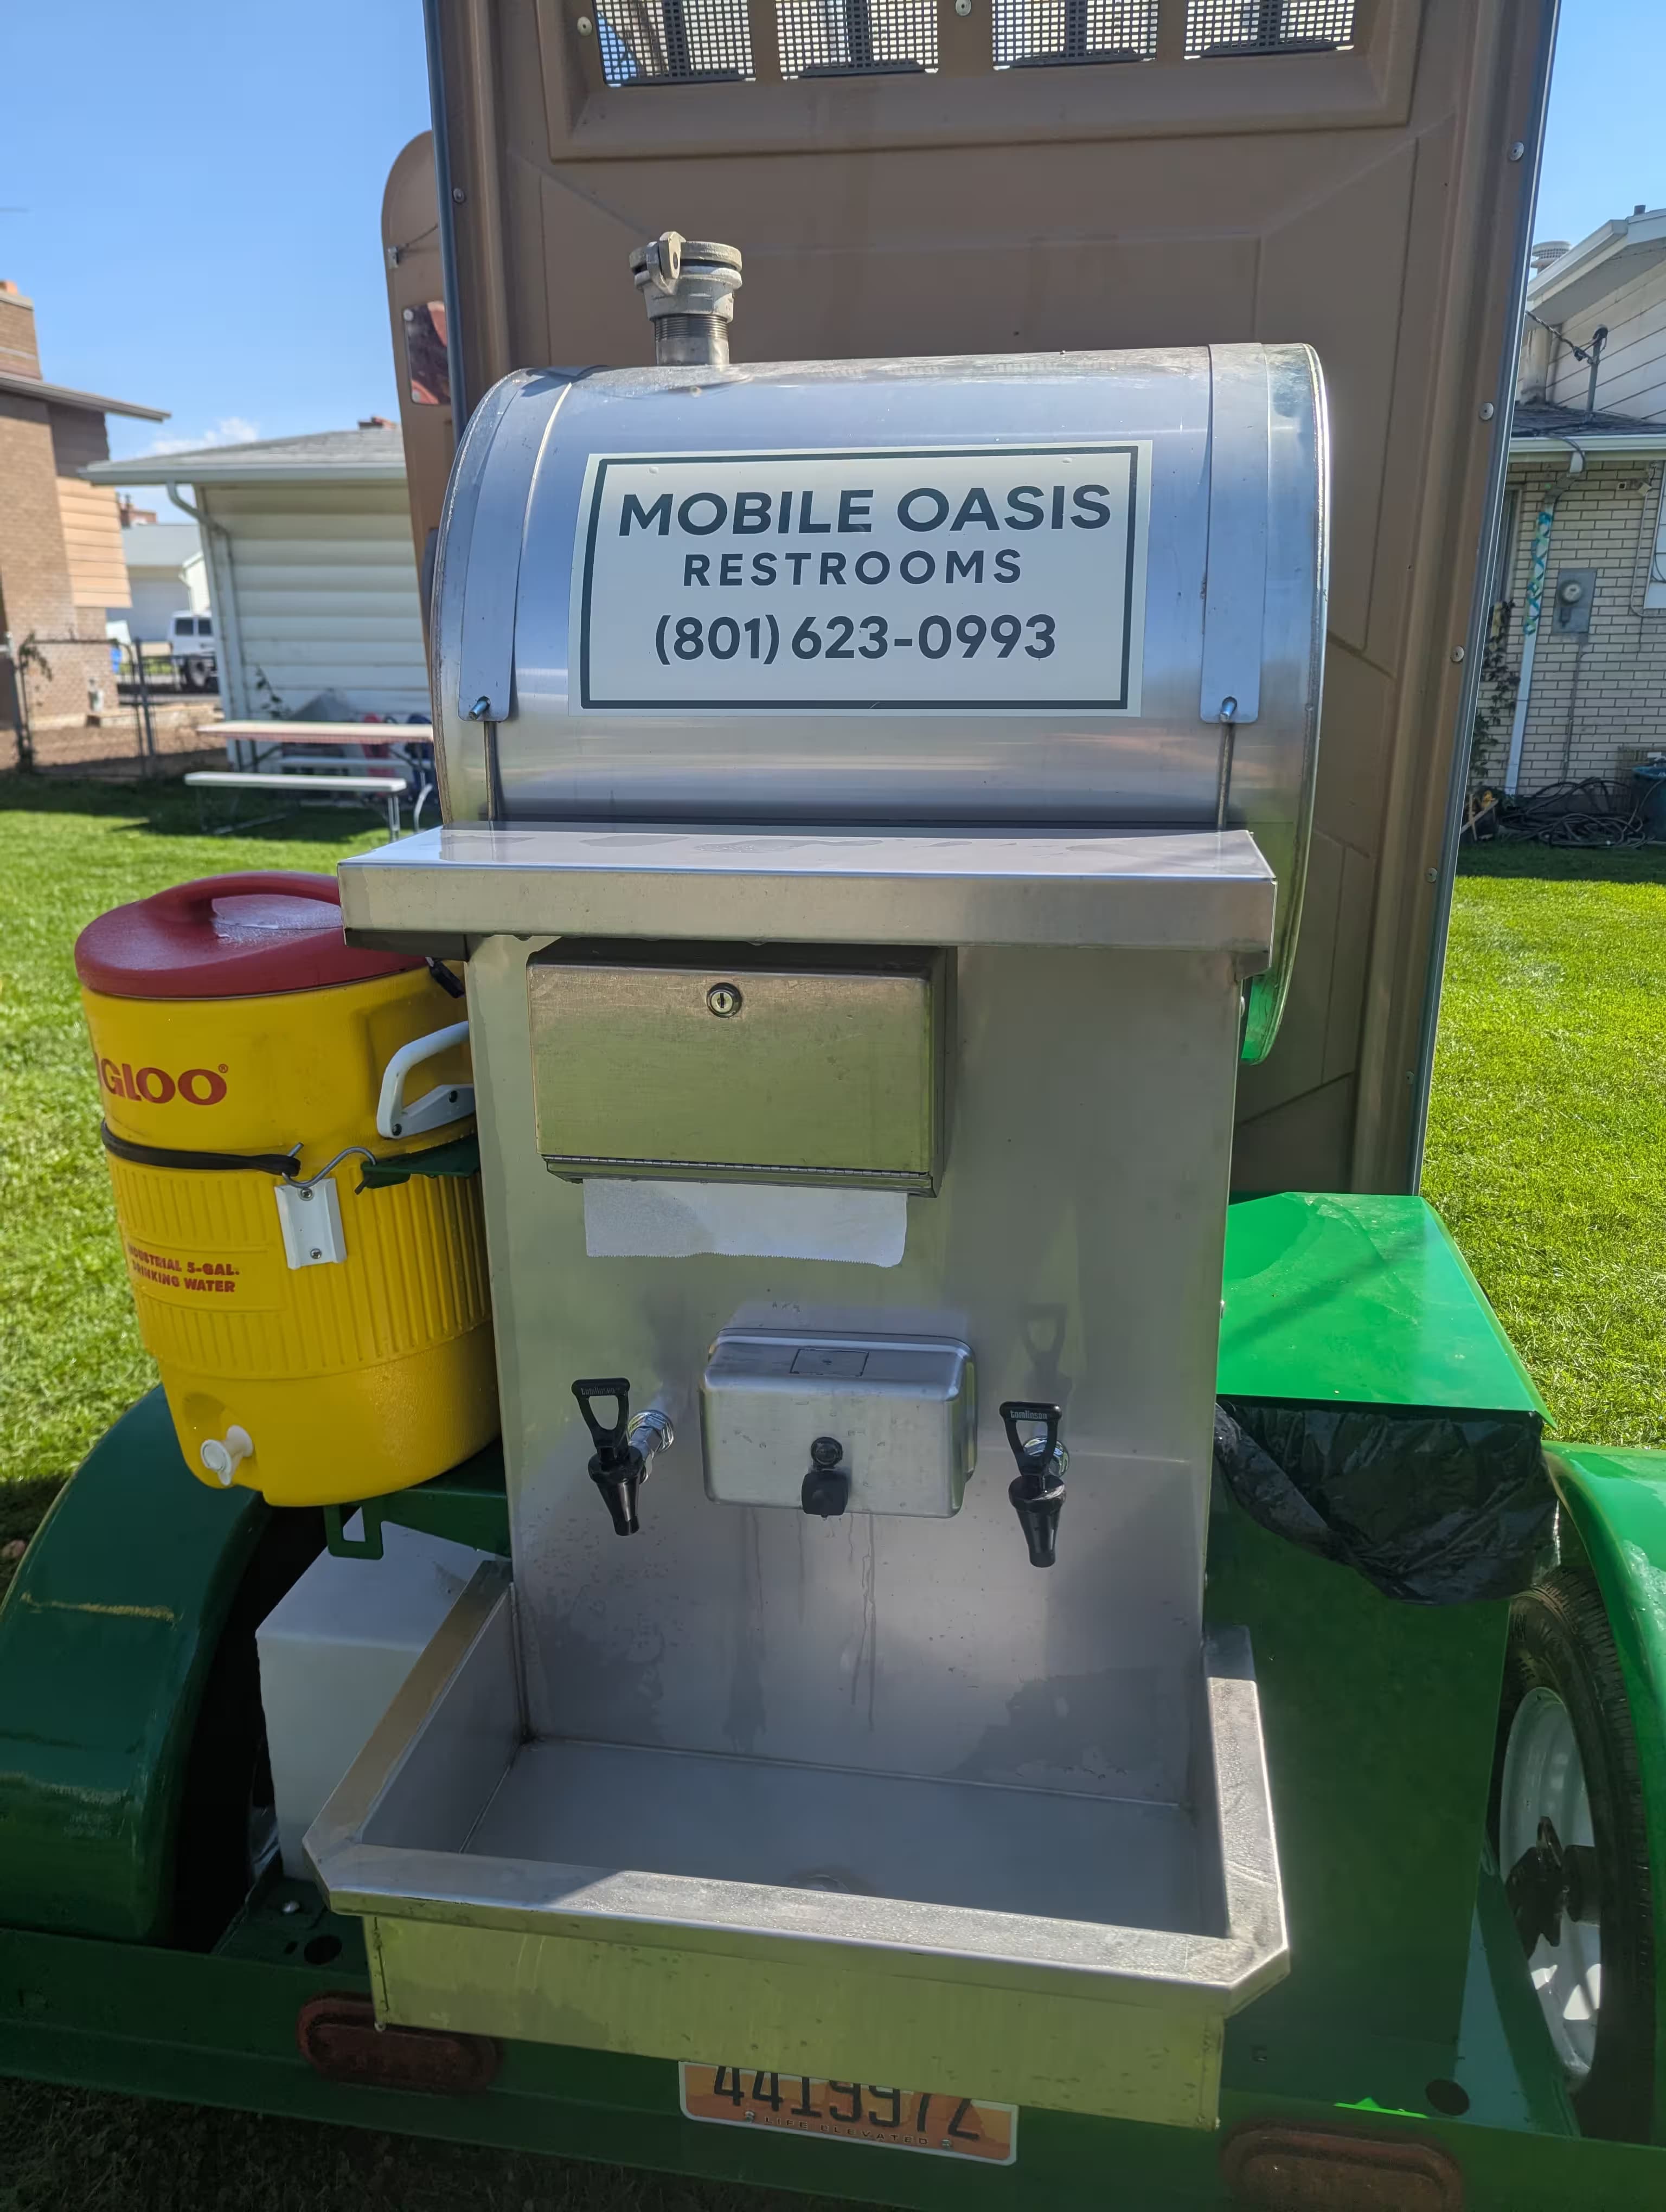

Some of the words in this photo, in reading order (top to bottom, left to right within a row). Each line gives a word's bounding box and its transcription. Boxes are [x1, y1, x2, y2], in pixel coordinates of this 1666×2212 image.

[619, 488, 874, 537] MOBILE
[896, 484, 1111, 533] OASIS
[683, 548, 1022, 587] RESTROOMS
[655, 613, 780, 665] (801)
[791, 613, 1056, 660] 623-0993
[94, 1052, 228, 1106] GLOO
[183, 1277, 236, 1293] WATER
[187, 1261, 240, 1276] 5-GAL.
[1010, 1410, 1048, 1420] tomlinson
[764, 2116, 808, 2130] LIFE
[819, 2124, 930, 2145] ELEVATED
